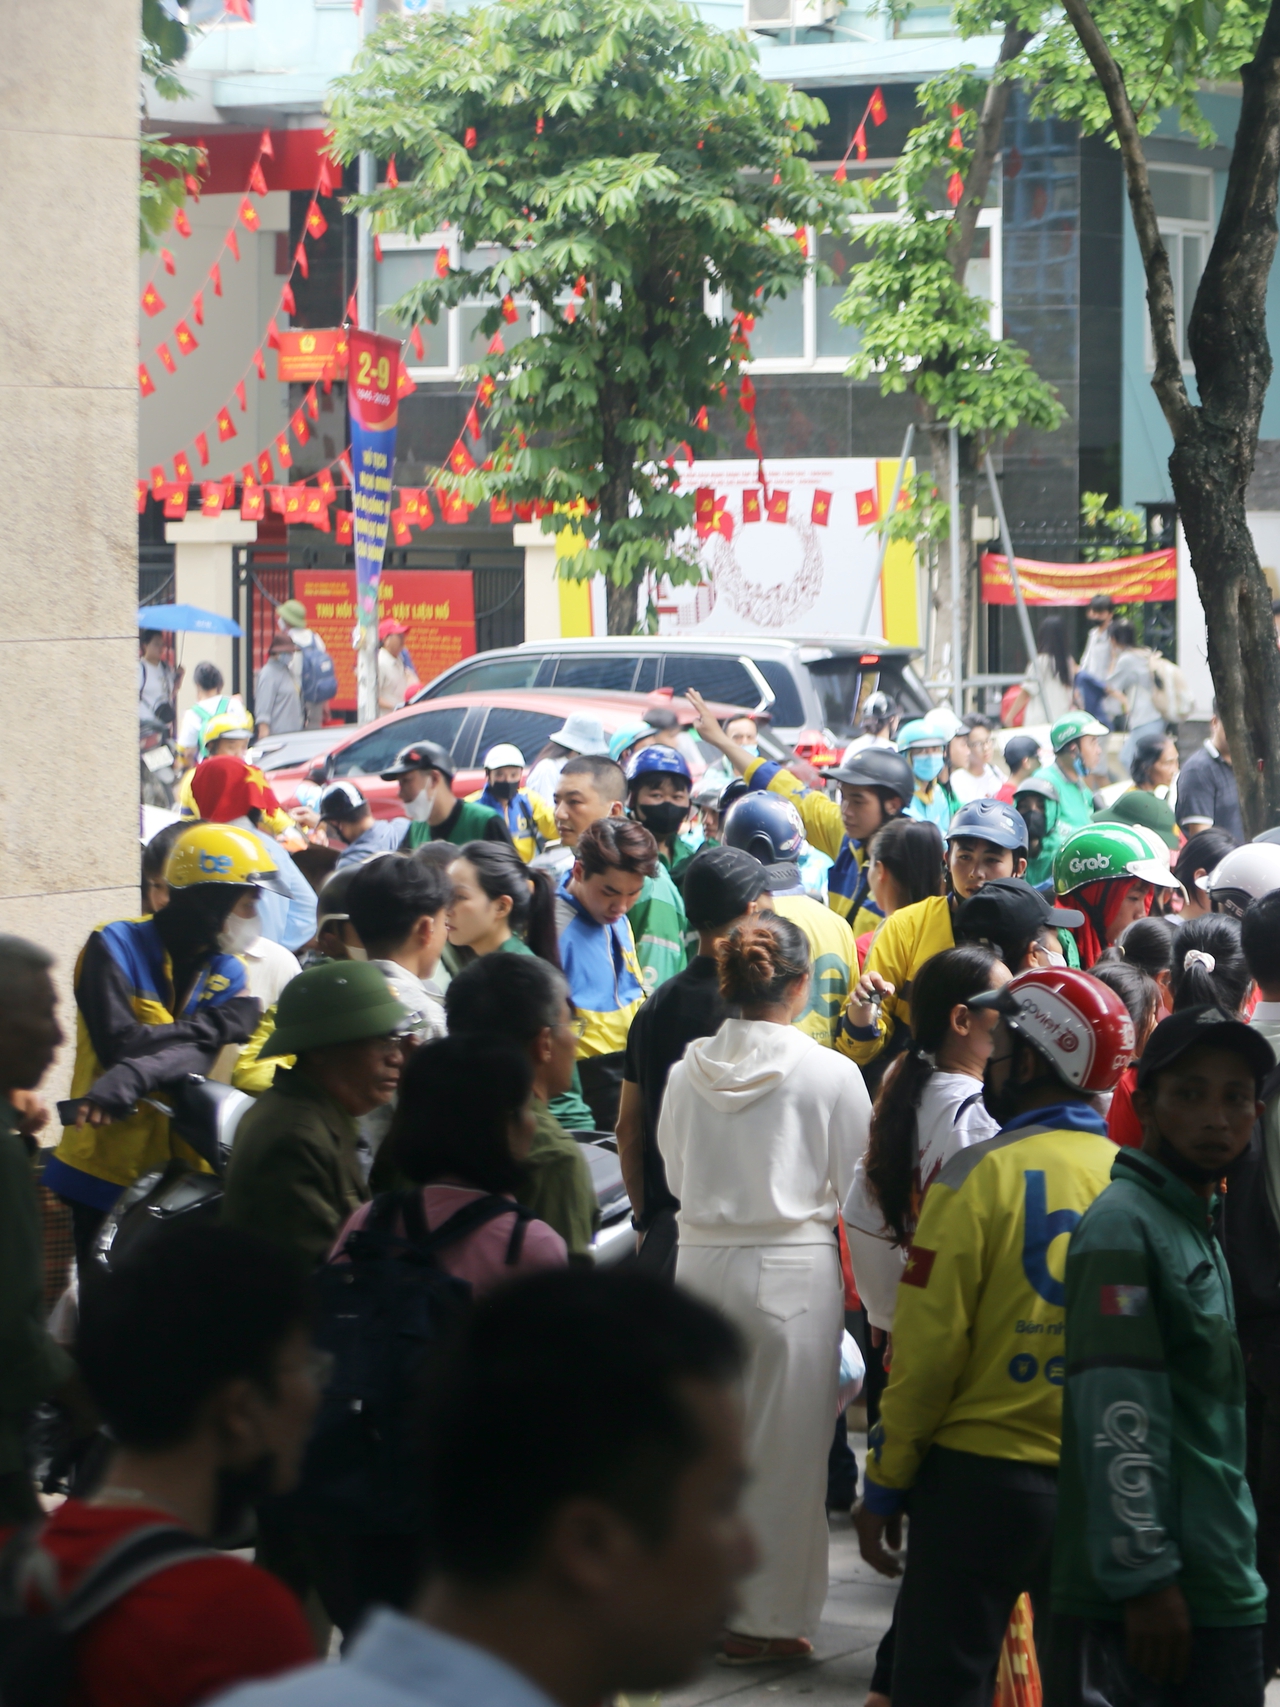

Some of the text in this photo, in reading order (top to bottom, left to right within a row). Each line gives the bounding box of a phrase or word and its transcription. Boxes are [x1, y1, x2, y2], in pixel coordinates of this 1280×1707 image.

[356, 351, 391, 391] 2-9
[198, 849, 235, 874] be
[1069, 853, 1111, 873] Grab
[1020, 998, 1061, 1034] goviet
